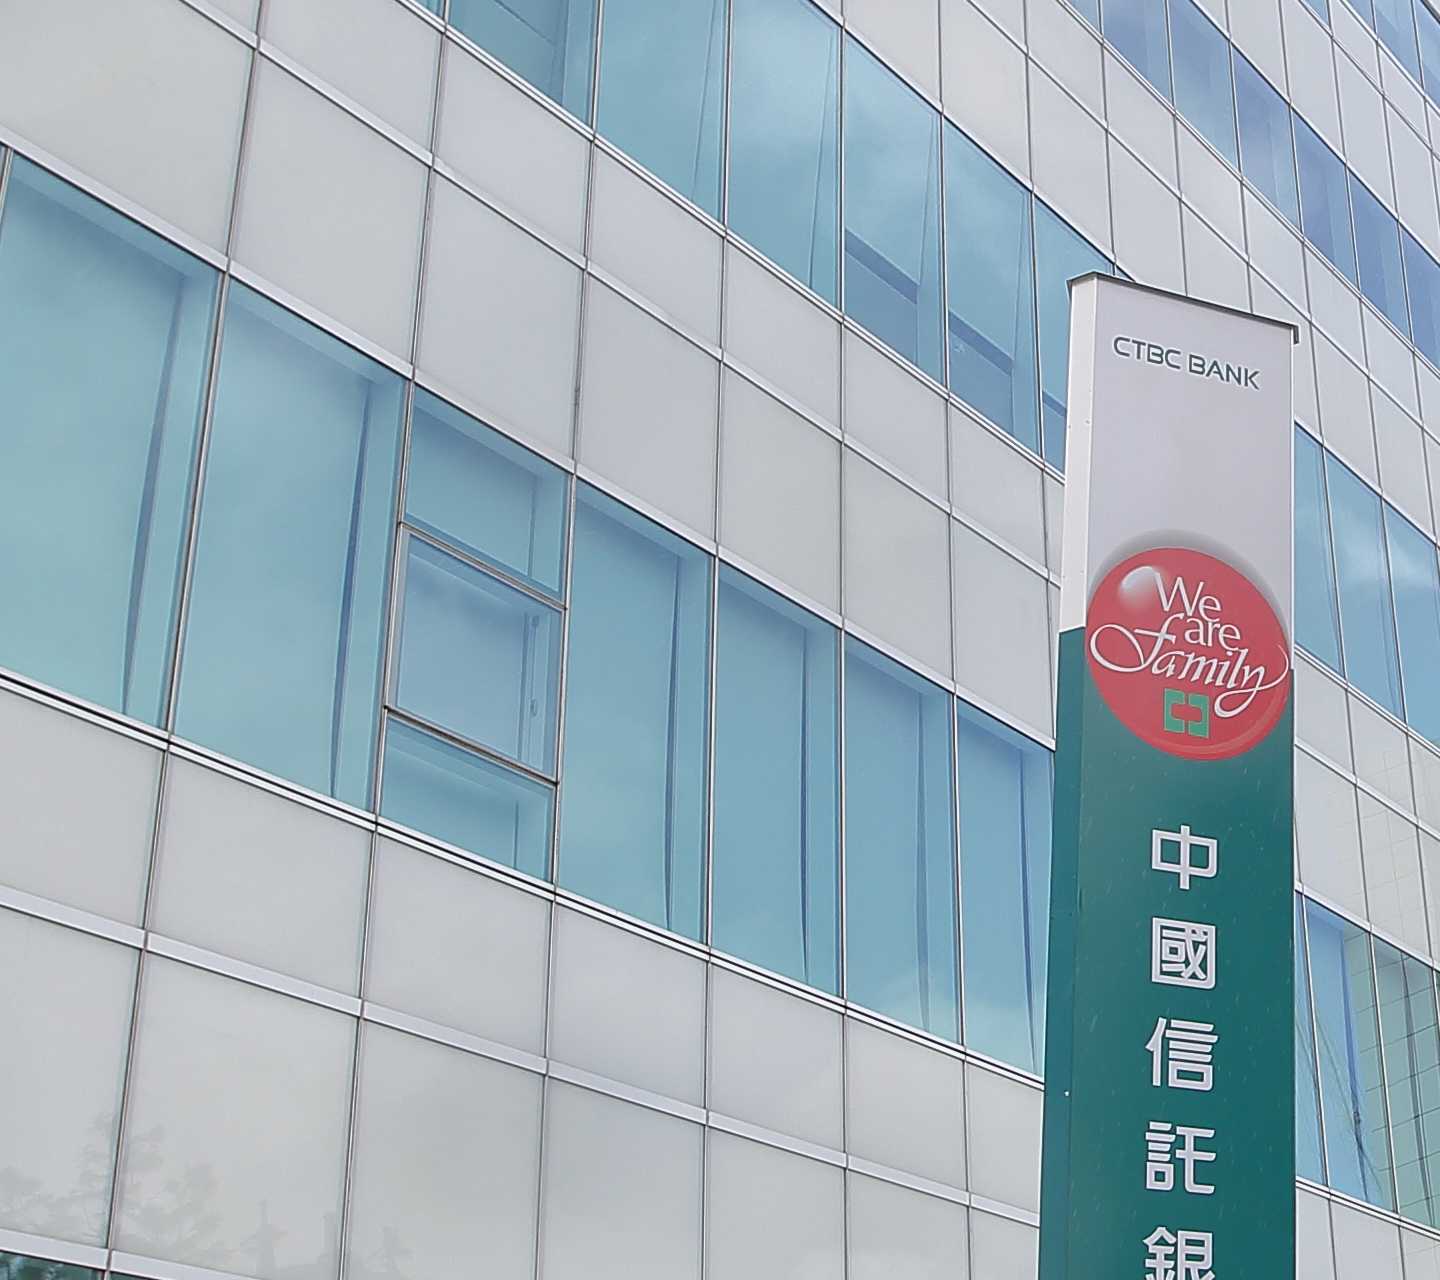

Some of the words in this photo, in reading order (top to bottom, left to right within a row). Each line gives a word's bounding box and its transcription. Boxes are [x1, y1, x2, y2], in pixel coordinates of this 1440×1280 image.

[1113, 336, 1182, 370] CTBC
[1188, 353, 1260, 391] BANK
[1154, 572, 1222, 623] We
[1184, 617, 1242, 652] are
[1090, 613, 1289, 718] Family
